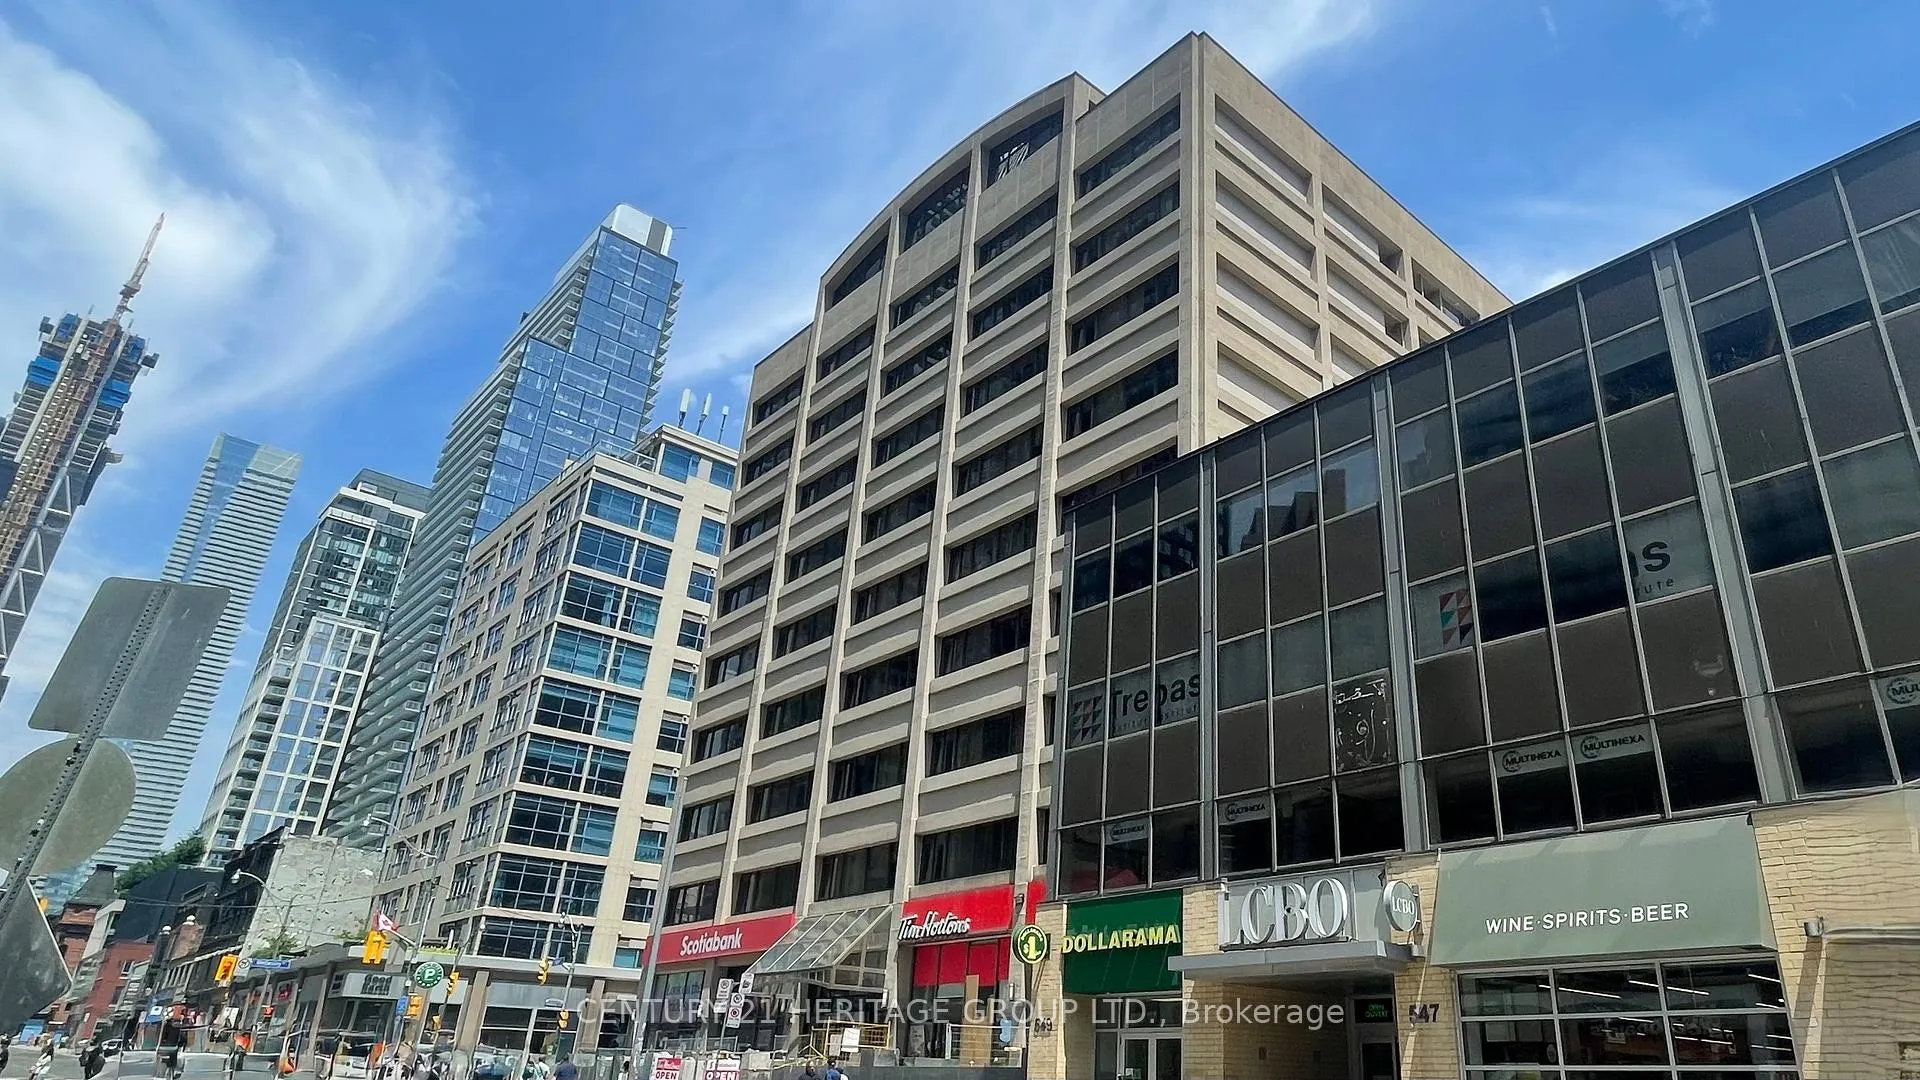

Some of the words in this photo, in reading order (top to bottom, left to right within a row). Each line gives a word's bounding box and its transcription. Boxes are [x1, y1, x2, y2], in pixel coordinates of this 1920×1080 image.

[1584, 734, 1645, 752] MULTIHEXA
[1504, 750, 1561, 765] MULTIHEXA
[1218, 877, 1348, 946] LCBO
[1391, 896, 1415, 915] LCBO
[898, 913, 922, 940] Tim
[920, 910, 972, 938] Hortons
[679, 926, 743, 957] Scotiabank
[1062, 924, 1181, 954] DOLLARAMA
[655, 1071, 677, 1080] OPEN
[706, 1071, 738, 1080] OPEN
